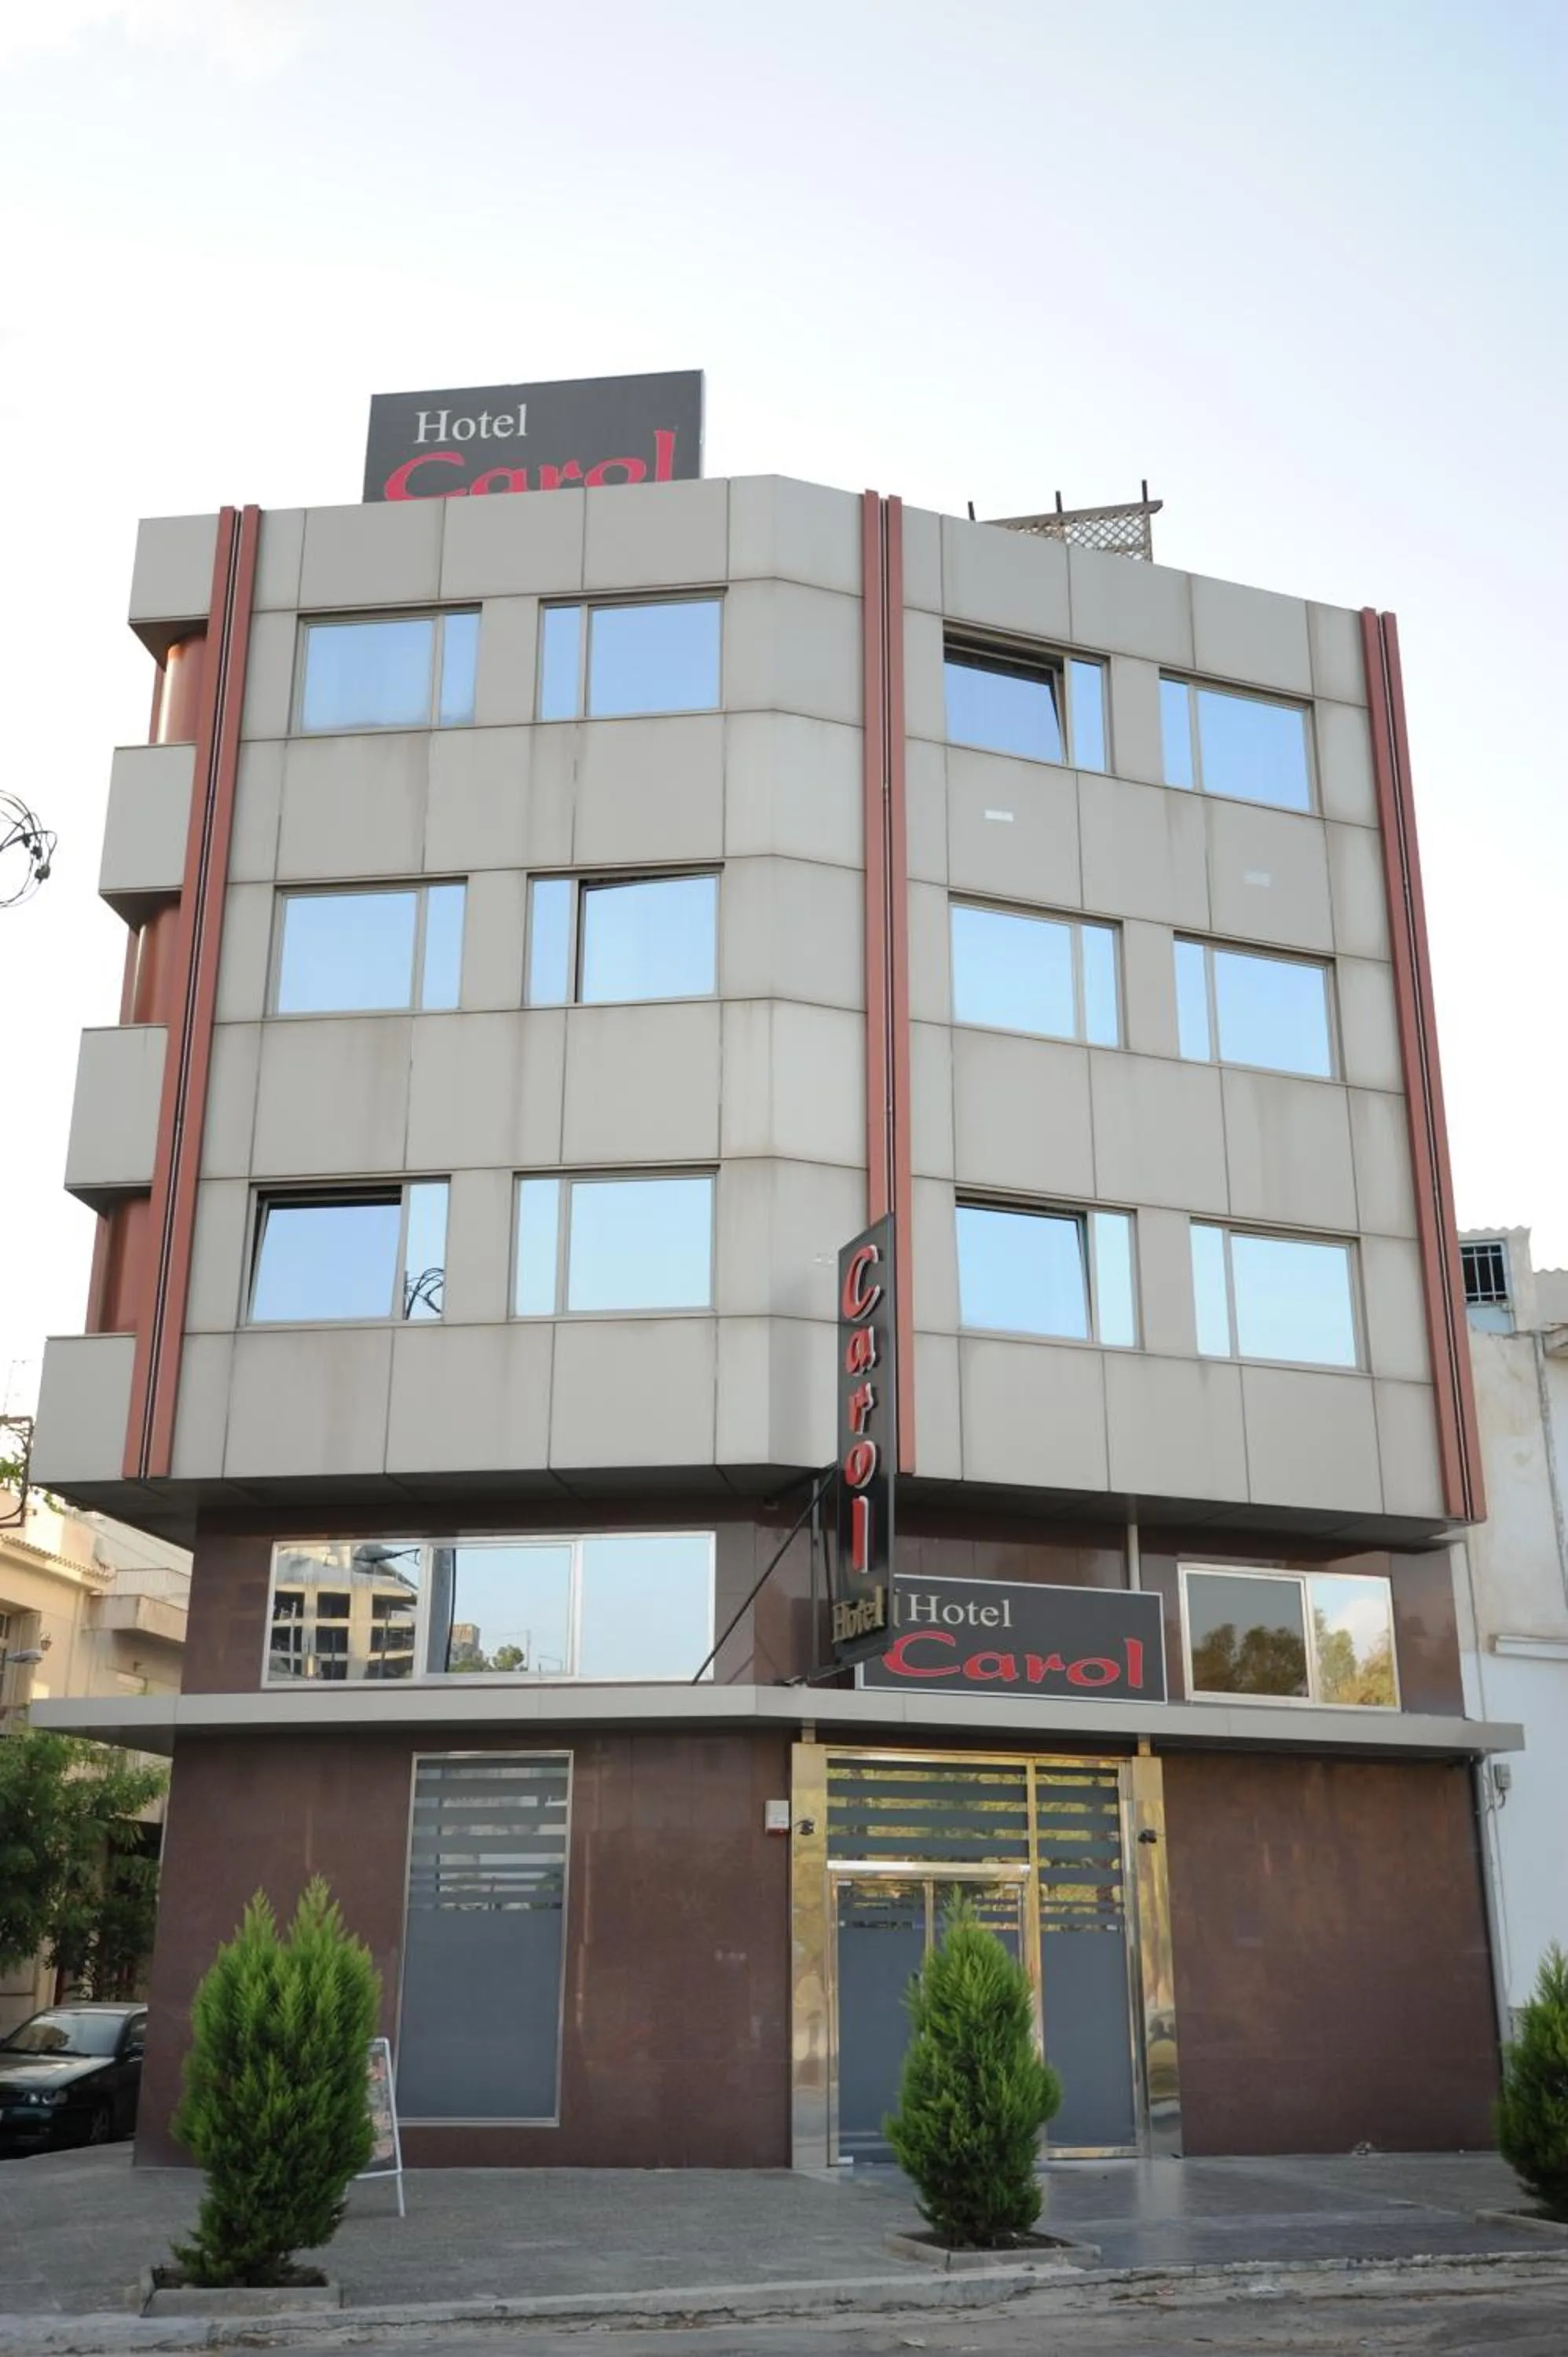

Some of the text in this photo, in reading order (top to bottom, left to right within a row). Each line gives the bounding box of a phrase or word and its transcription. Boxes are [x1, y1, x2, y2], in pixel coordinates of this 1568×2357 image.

[413, 403, 528, 444] Hotel
[383, 427, 676, 502] Carol
[843, 1244, 881, 1573] Carol
[831, 1585, 885, 1644] Hotel
[906, 1594, 1013, 1628] Hotel
[881, 1630, 1144, 1689] Carol
